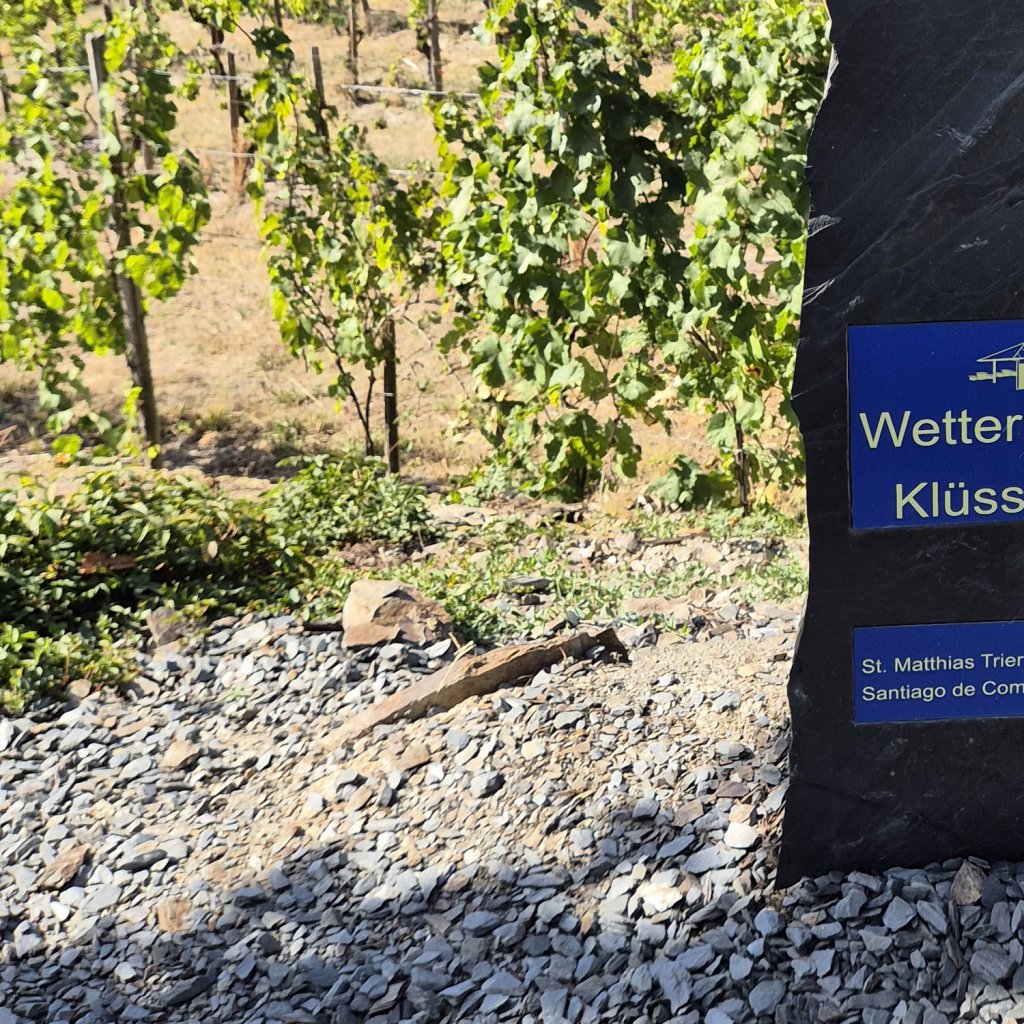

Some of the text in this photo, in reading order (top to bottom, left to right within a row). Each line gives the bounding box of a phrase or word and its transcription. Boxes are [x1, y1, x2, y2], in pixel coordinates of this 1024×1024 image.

[861, 659, 887, 674] St.
[894, 655, 975, 674] Matthias
[980, 653, 1024, 669] Trier
[861, 685, 947, 702] Santiago
[952, 683, 976, 697] de
